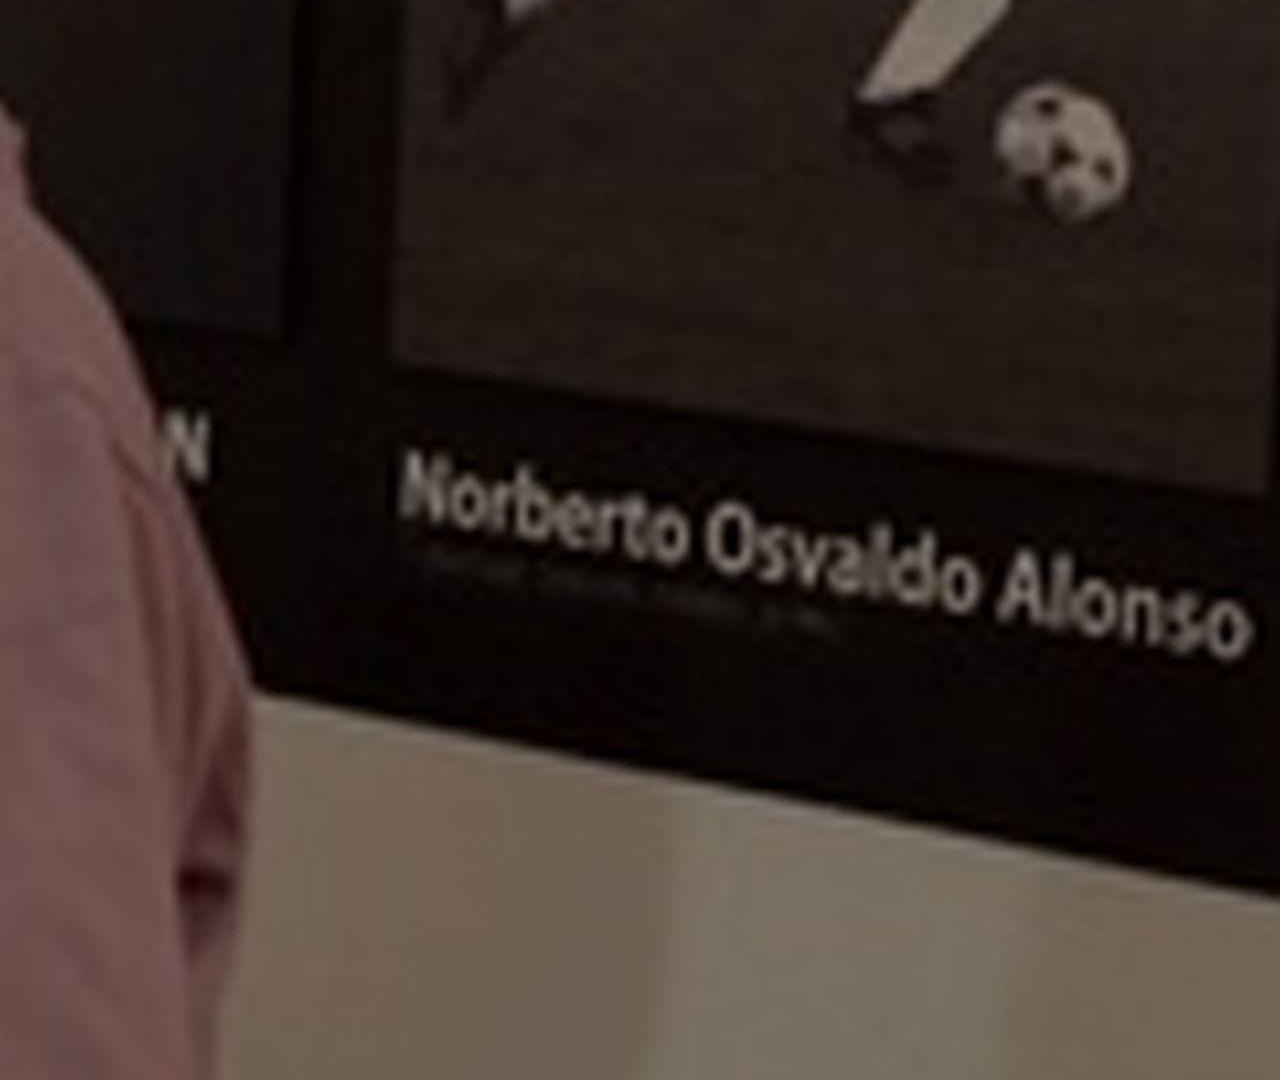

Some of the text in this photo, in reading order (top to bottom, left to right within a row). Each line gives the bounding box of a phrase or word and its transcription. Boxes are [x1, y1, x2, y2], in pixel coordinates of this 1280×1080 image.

[400, 449, 691, 563] Norberto
[706, 501, 981, 614] Osvaldo
[996, 550, 1253, 659] Alonso
